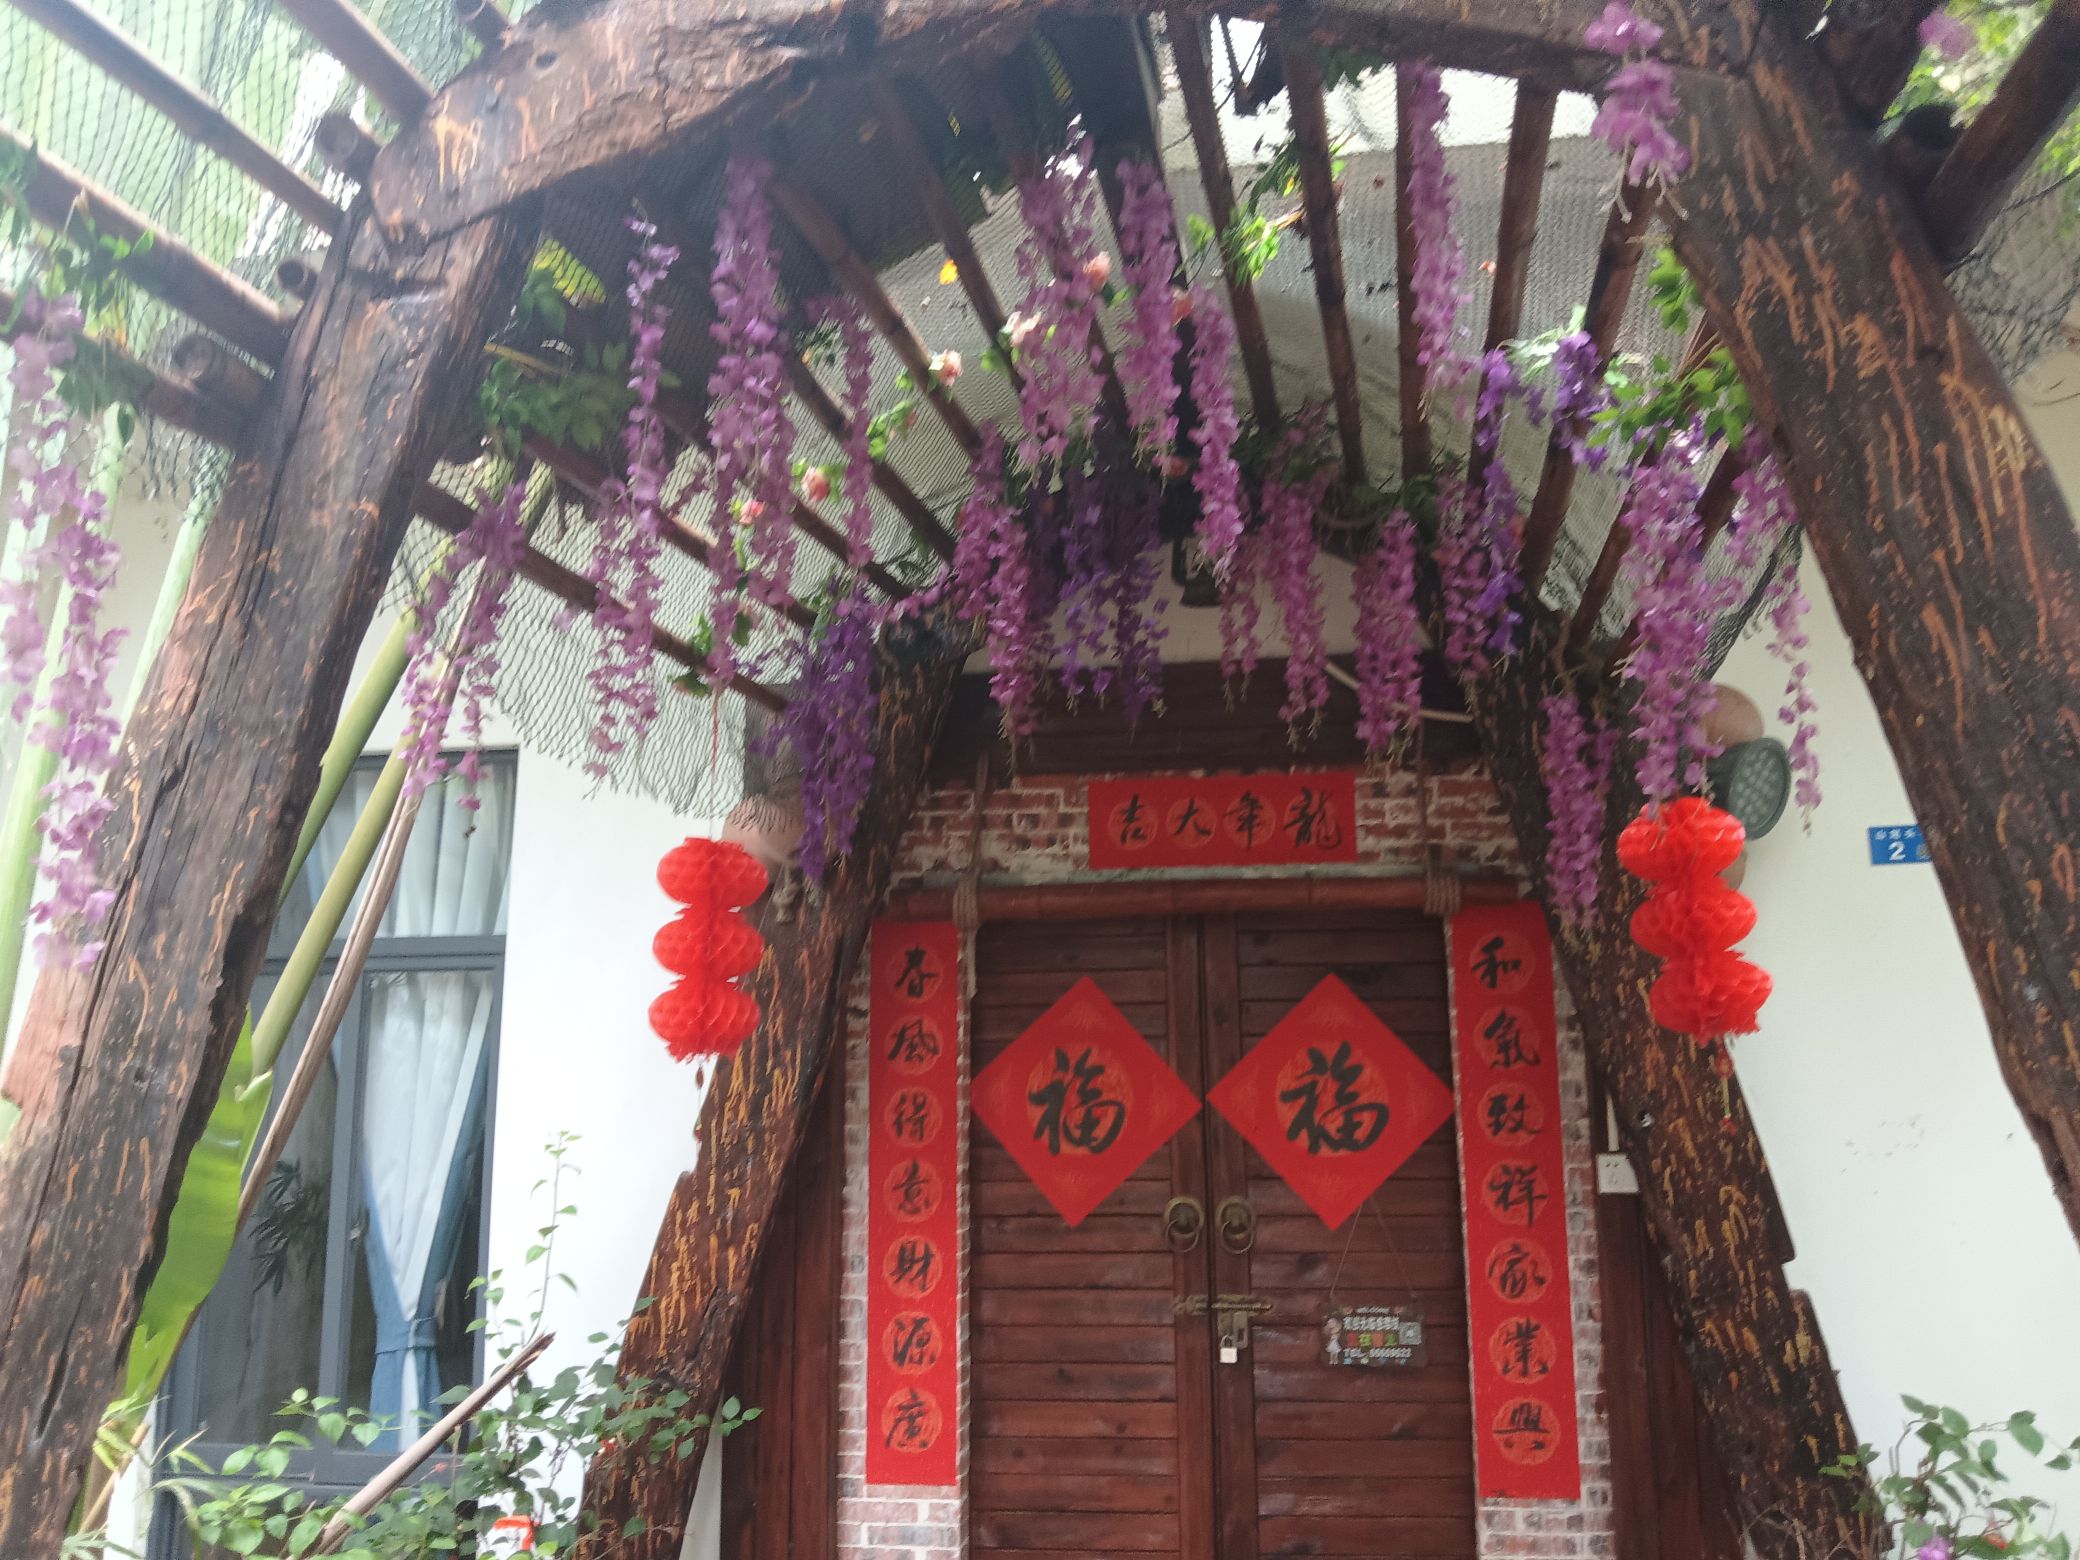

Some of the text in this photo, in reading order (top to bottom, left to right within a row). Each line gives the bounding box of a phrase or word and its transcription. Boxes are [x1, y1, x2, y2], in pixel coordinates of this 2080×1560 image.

[1888, 841, 1906, 861] 2
[1027, 1046, 1126, 1156] 福
[1280, 1040, 1390, 1156] 福
